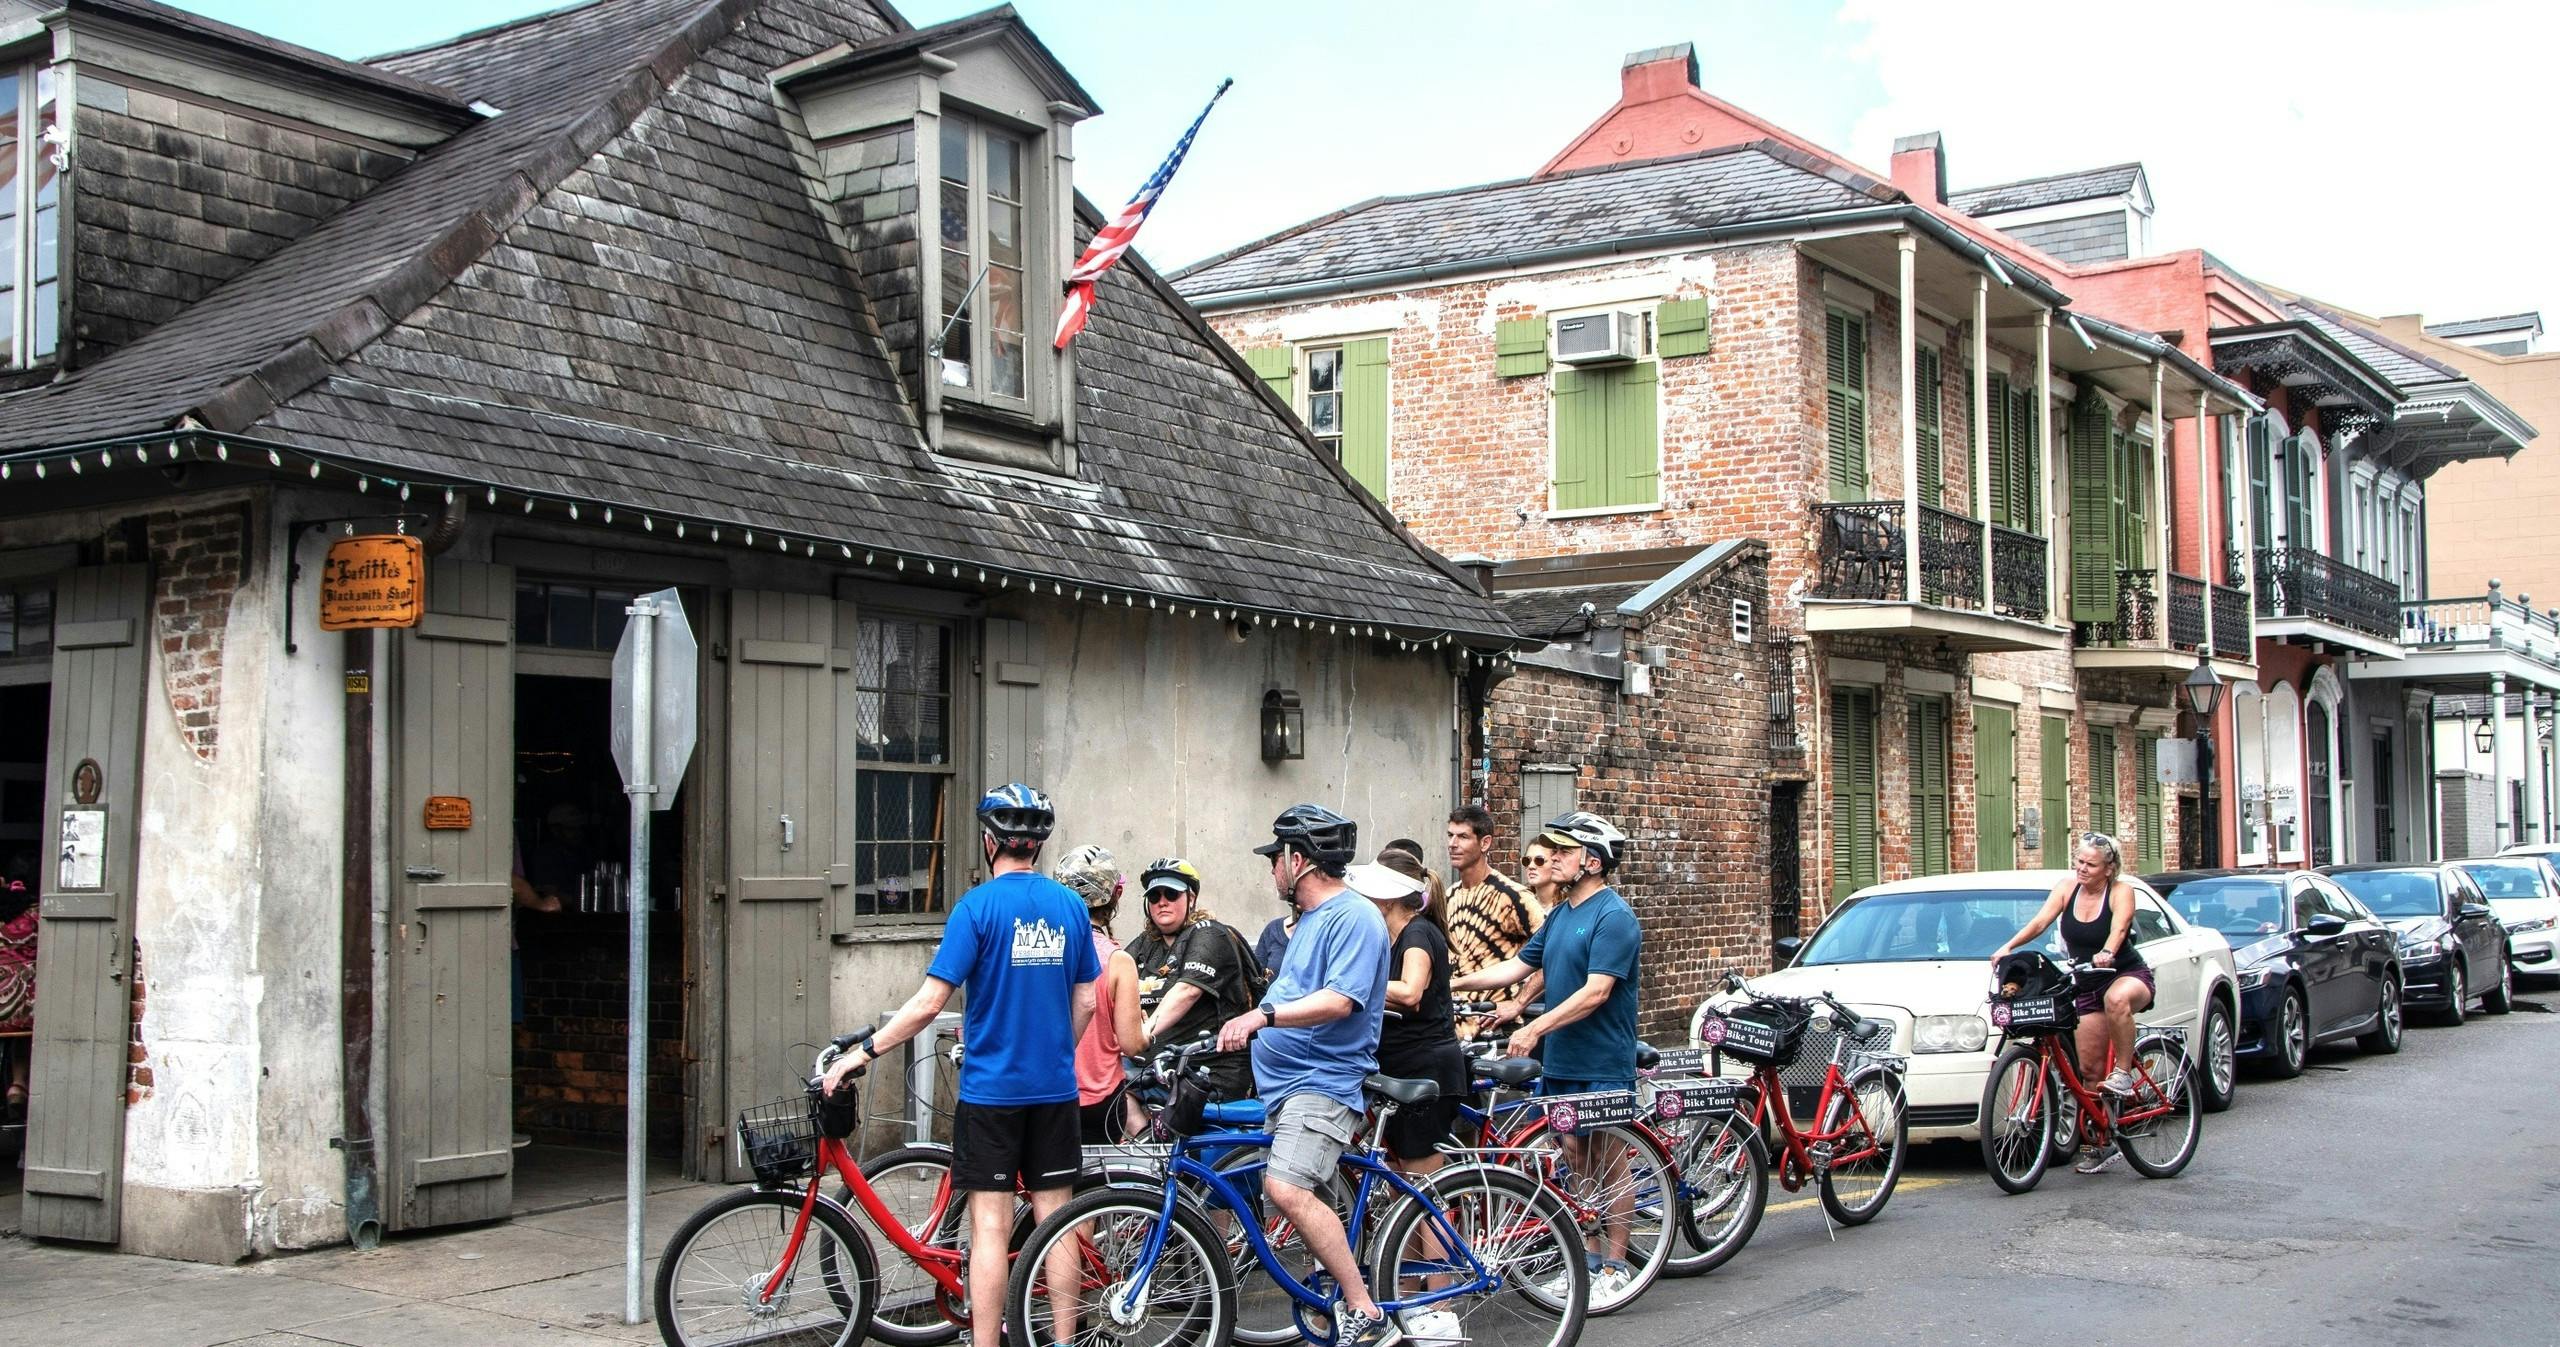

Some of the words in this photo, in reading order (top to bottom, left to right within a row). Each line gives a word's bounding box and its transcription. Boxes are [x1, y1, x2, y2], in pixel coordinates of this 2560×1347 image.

[337, 559, 401, 586] Lafitte's
[325, 587, 382, 604] Blacksmith
[387, 586, 412, 602] Shop
[1043, 949, 1063, 957] HORS
[1184, 961, 1216, 977] KOHLER
[2012, 1008, 2029, 1017] Bike
[2030, 1007, 2053, 1015] Tours
[1726, 1029, 1746, 1041] Bike
[1748, 1034, 1775, 1048] Tours
[1659, 1058, 1677, 1067] Bike
[1678, 1057, 1703, 1065] Tours
[1683, 1098, 1705, 1108] Bike
[1707, 1096, 1735, 1106] Tours
[1578, 1109, 1601, 1120] Bike
[1603, 1107, 1633, 1118] Tours
